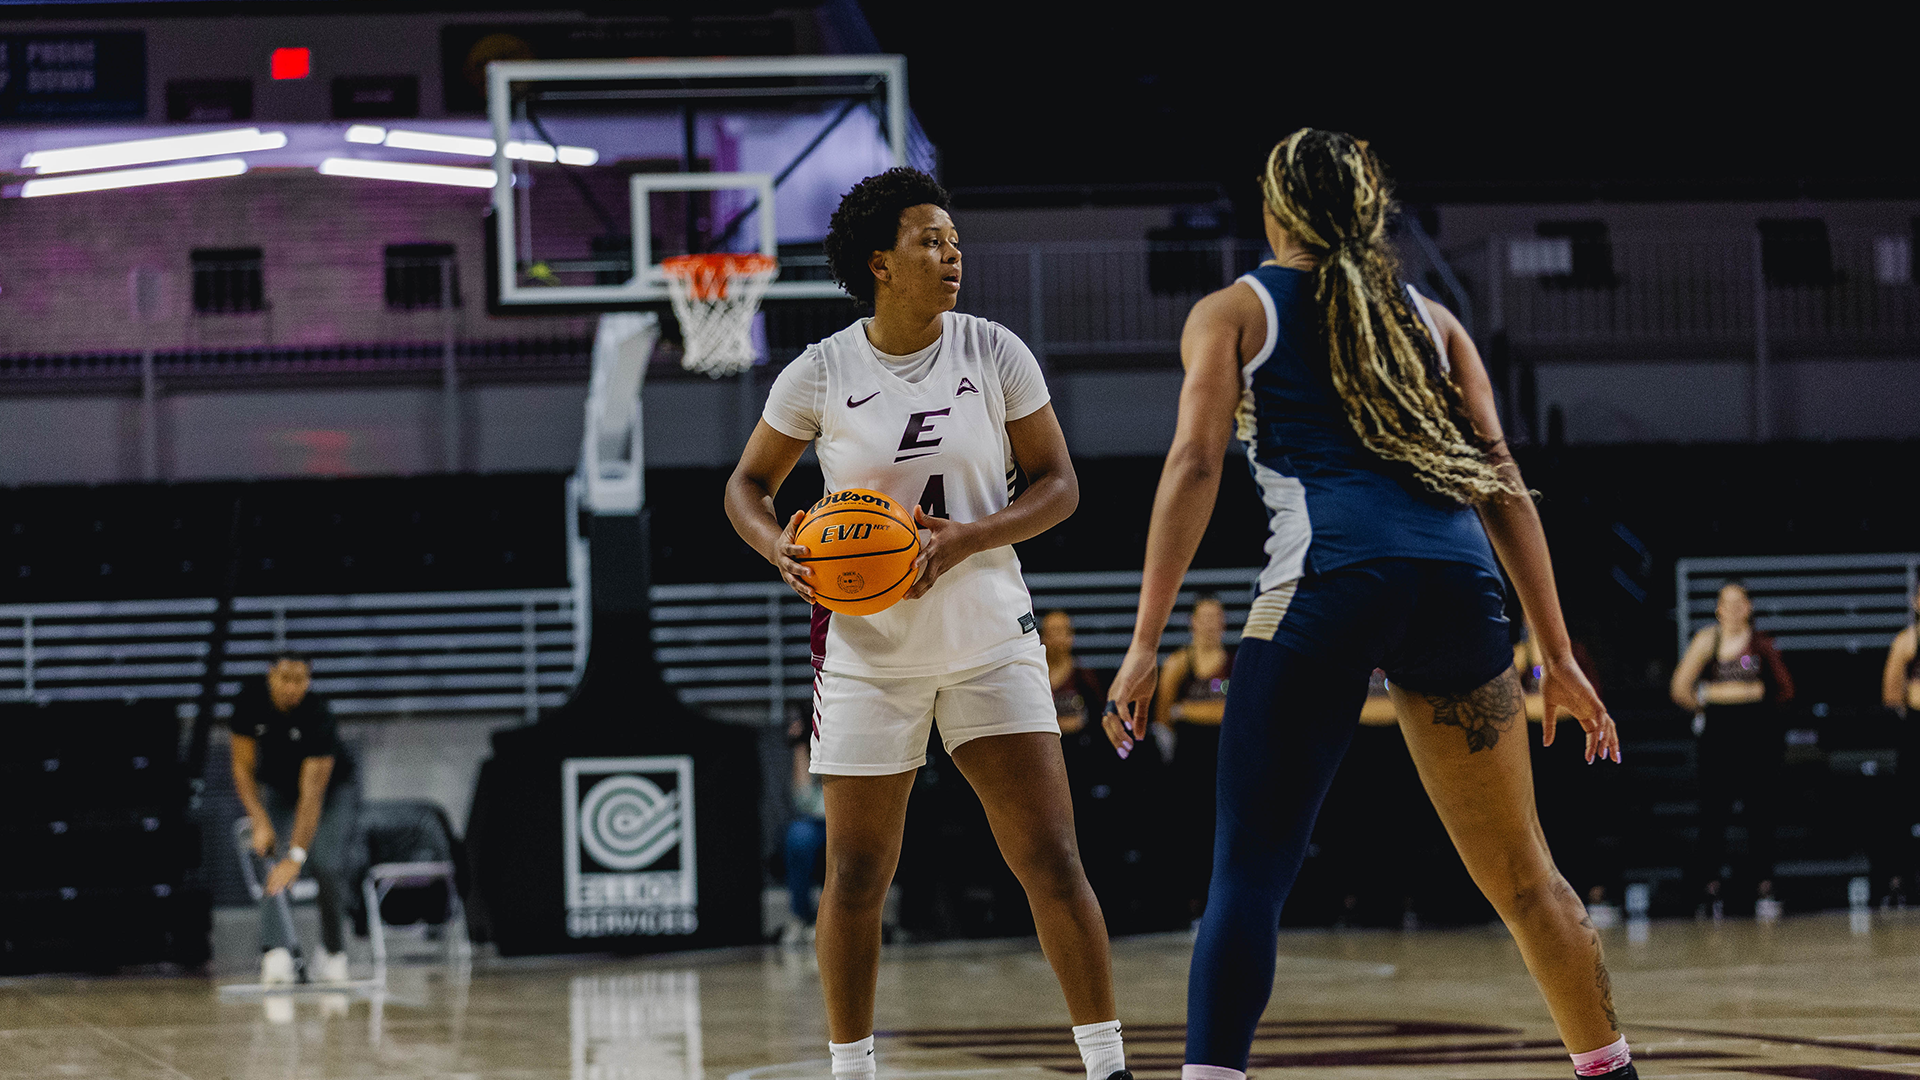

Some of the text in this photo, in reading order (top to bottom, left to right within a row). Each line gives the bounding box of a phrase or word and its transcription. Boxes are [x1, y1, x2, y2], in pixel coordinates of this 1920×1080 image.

[896, 406, 952, 452] E
[810, 490, 891, 515] Wilson
[820, 523, 891, 545] EVO NXT
[567, 910, 698, 937] SERVICES
